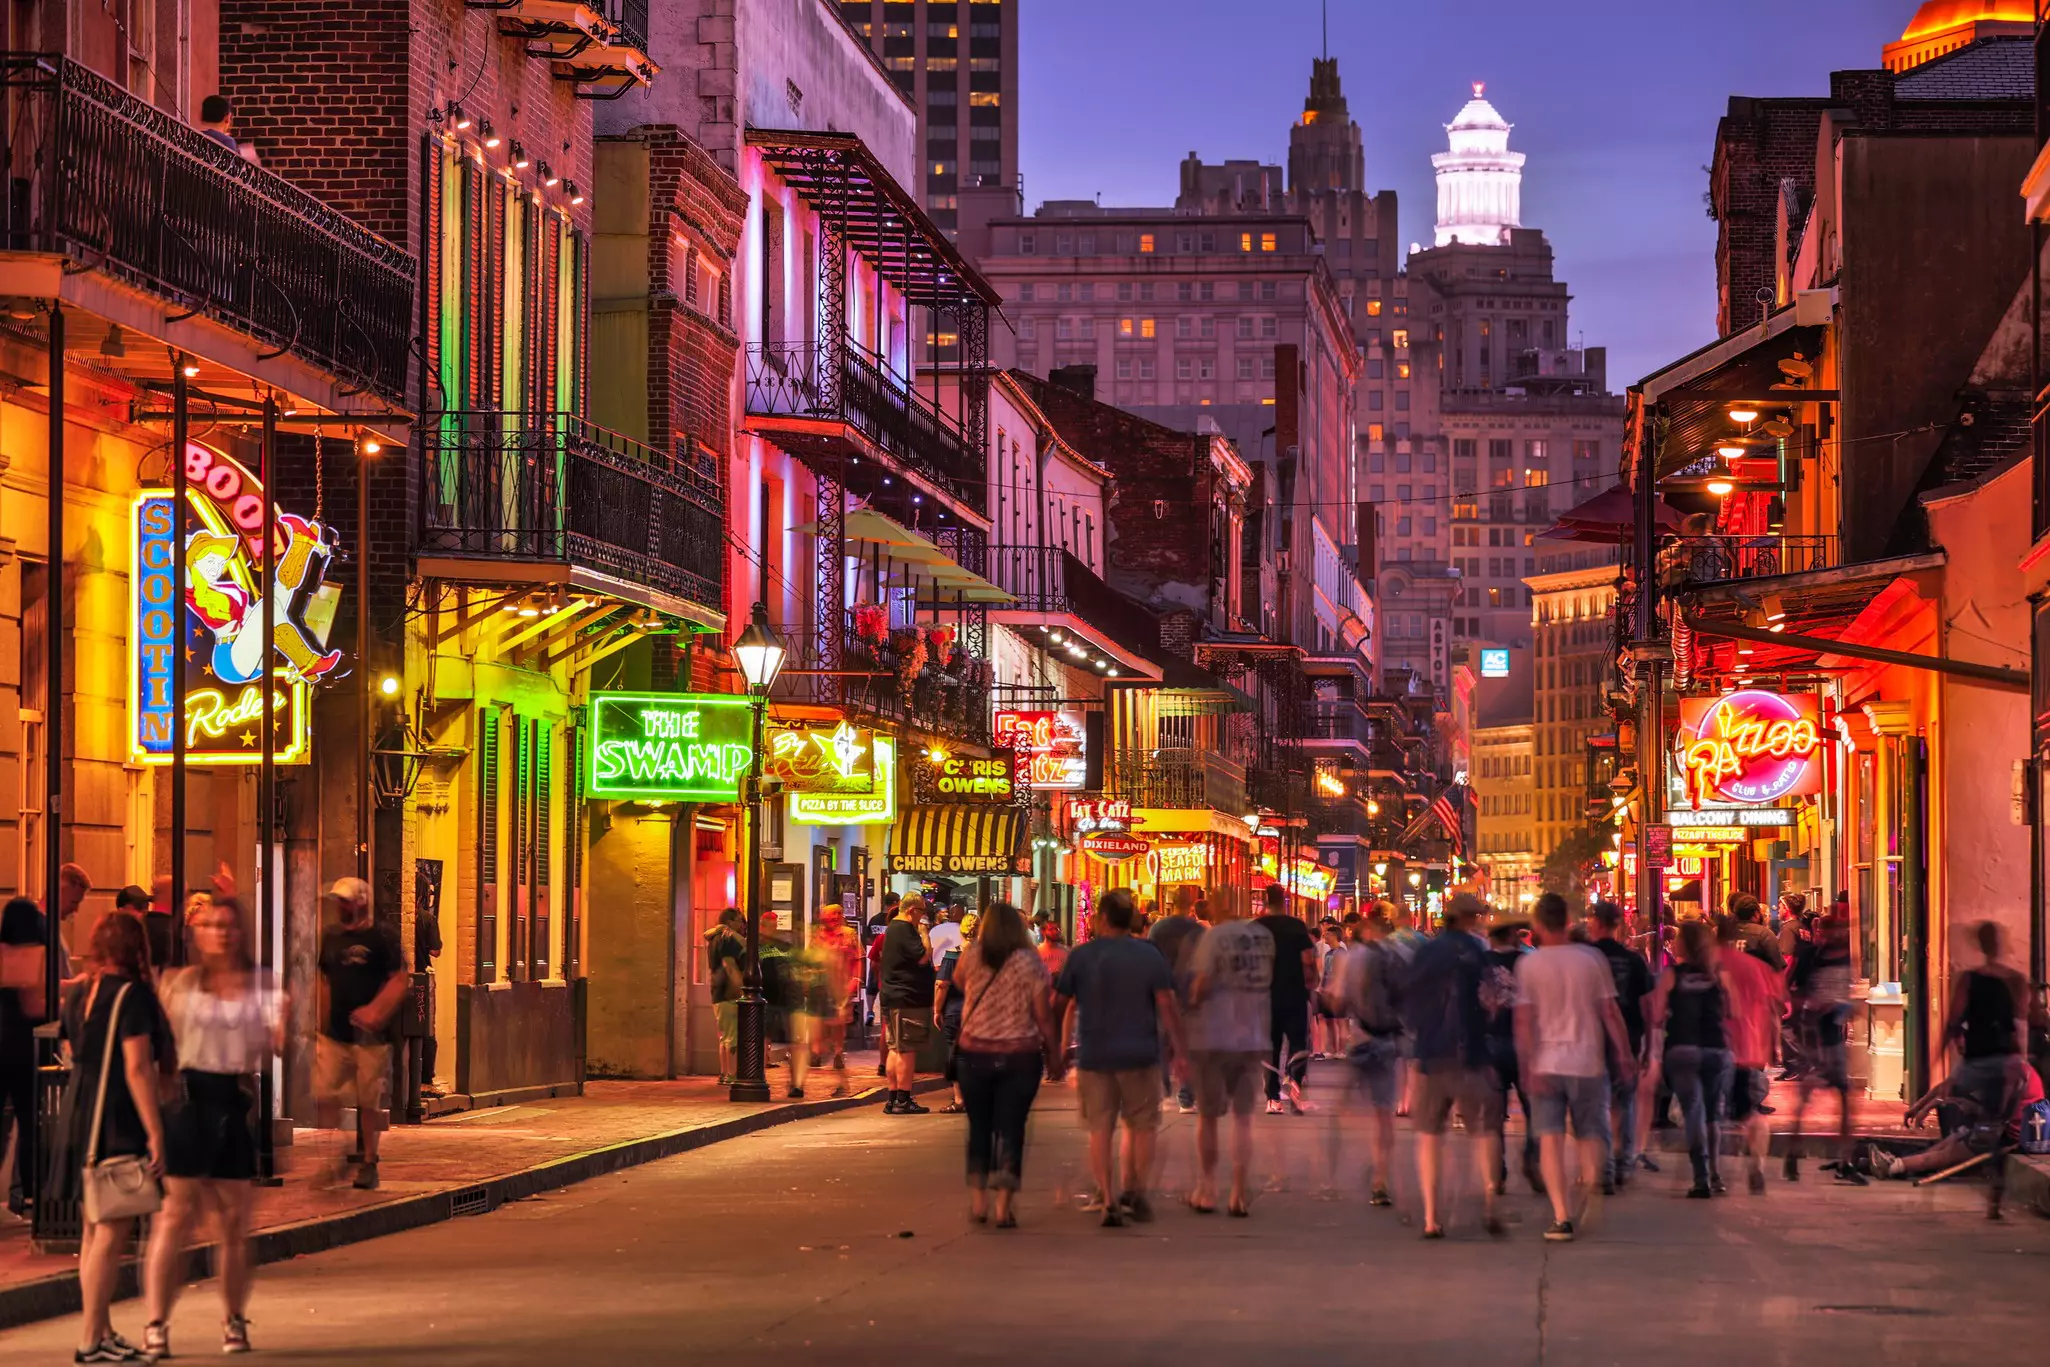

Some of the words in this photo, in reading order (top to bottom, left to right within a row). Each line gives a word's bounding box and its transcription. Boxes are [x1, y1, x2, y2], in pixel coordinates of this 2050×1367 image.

[142, 505, 174, 742] SCOOTIN
[1484, 652, 1507, 665] AC
[641, 709, 700, 738] THE
[596, 739, 753, 784] SWAMP
[943, 759, 1007, 776] CRIS
[938, 777, 1011, 794] OWENS
[1731, 782, 1757, 796] CLUB
[1771, 761, 1797, 791] PATIO
[800, 799, 825, 811] PIZZA
[827, 799, 839, 811] BY
[840, 799, 857, 811] THE
[858, 799, 883, 811] SLICE
[1670, 811, 1735, 826] BALCONY
[1739, 810, 1788, 825] DINING
[1083, 839, 1148, 852] DIXIELAND
[892, 856, 943, 871] CHRIS
[949, 856, 1008, 871] OWENS
[1681, 857, 1701, 875] CLUB
